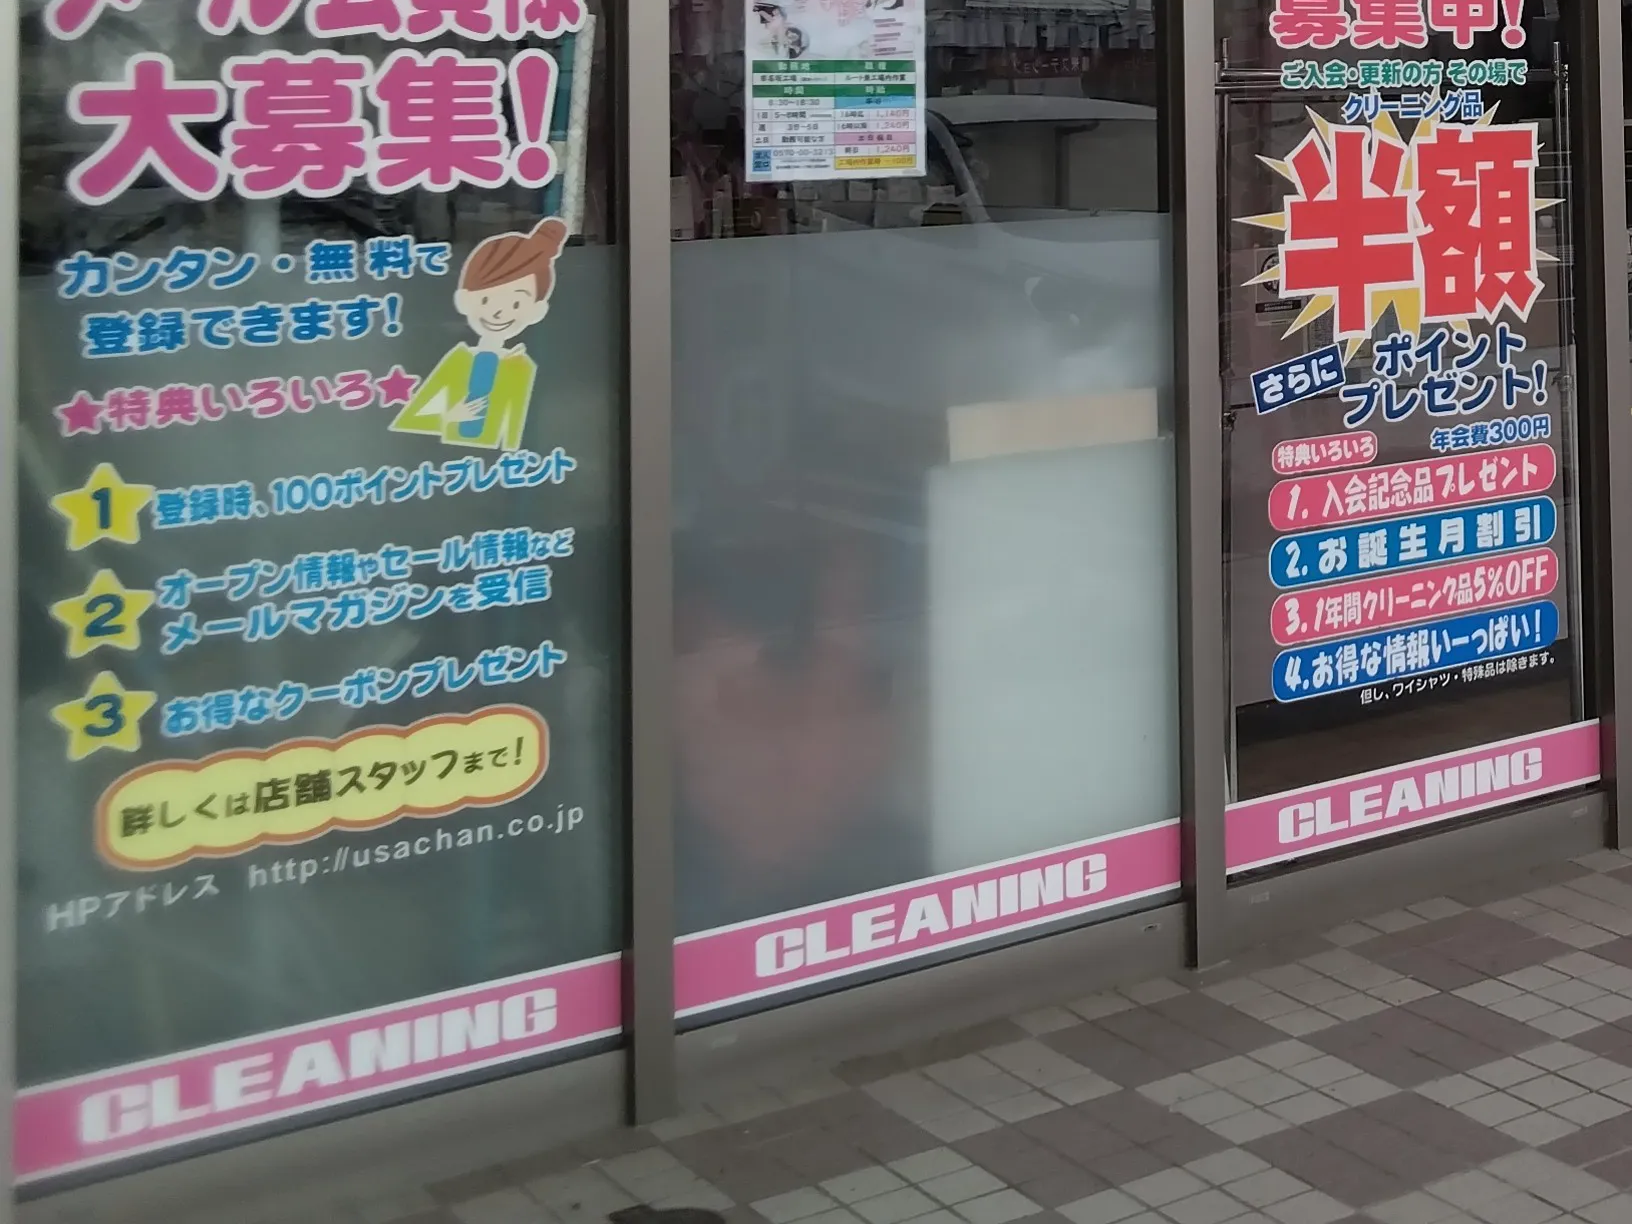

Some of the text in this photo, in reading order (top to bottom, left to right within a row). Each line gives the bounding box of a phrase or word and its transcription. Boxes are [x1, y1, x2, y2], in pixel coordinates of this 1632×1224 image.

[1342, 89, 1485, 123] クリーニング品
[1447, 59, 1527, 88] その場で
[67, 48, 560, 206] 大募集!
[1278, 123, 1545, 342] 半額
[57, 236, 451, 300] カンタン・無料で
[83, 295, 403, 359] 登録できます!
[1373, 323, 1526, 377] ポイント
[1258, 353, 1338, 406] さらに
[1340, 361, 1548, 428] プレゼント!
[1277, 434, 1376, 470] 特典いろいろ
[1431, 415, 1550, 452] 年会費300円
[90, 488, 111, 528] 1
[152, 448, 576, 529] 登録時、100ポイントプレゼント
[1325, 462, 1539, 516] 入会記念品プレゼント
[158, 527, 575, 610] オープン情報やセール情報など
[84, 594, 124, 637] 2
[160, 567, 551, 654] メールマガジンを受信
[84, 694, 124, 737] 3
[161, 640, 567, 738] お得なクーポンプレゼント
[121, 737, 525, 838] 詳しくは店舗スタッフまで!
[1278, 746, 1543, 845] CLEANING
[45, 804, 585, 932] HPアドレス http://usachan.co.jp
[754, 851, 1107, 979] CLEANING
[79, 987, 558, 1145] CLEANING
